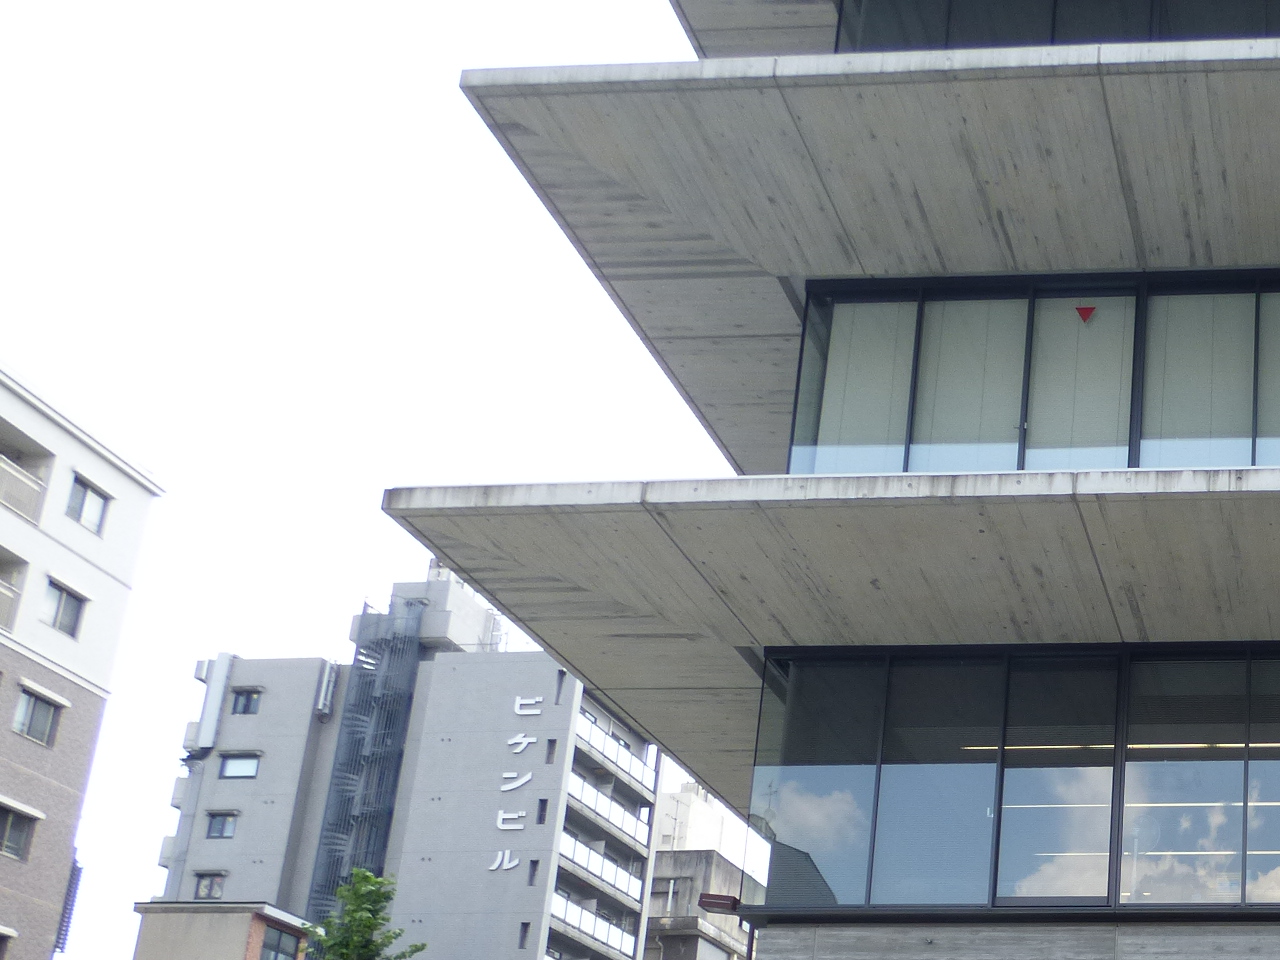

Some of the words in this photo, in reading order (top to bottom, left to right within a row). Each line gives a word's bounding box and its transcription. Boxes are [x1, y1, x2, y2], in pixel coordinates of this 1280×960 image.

[488, 695, 543, 872] ビケンビル
